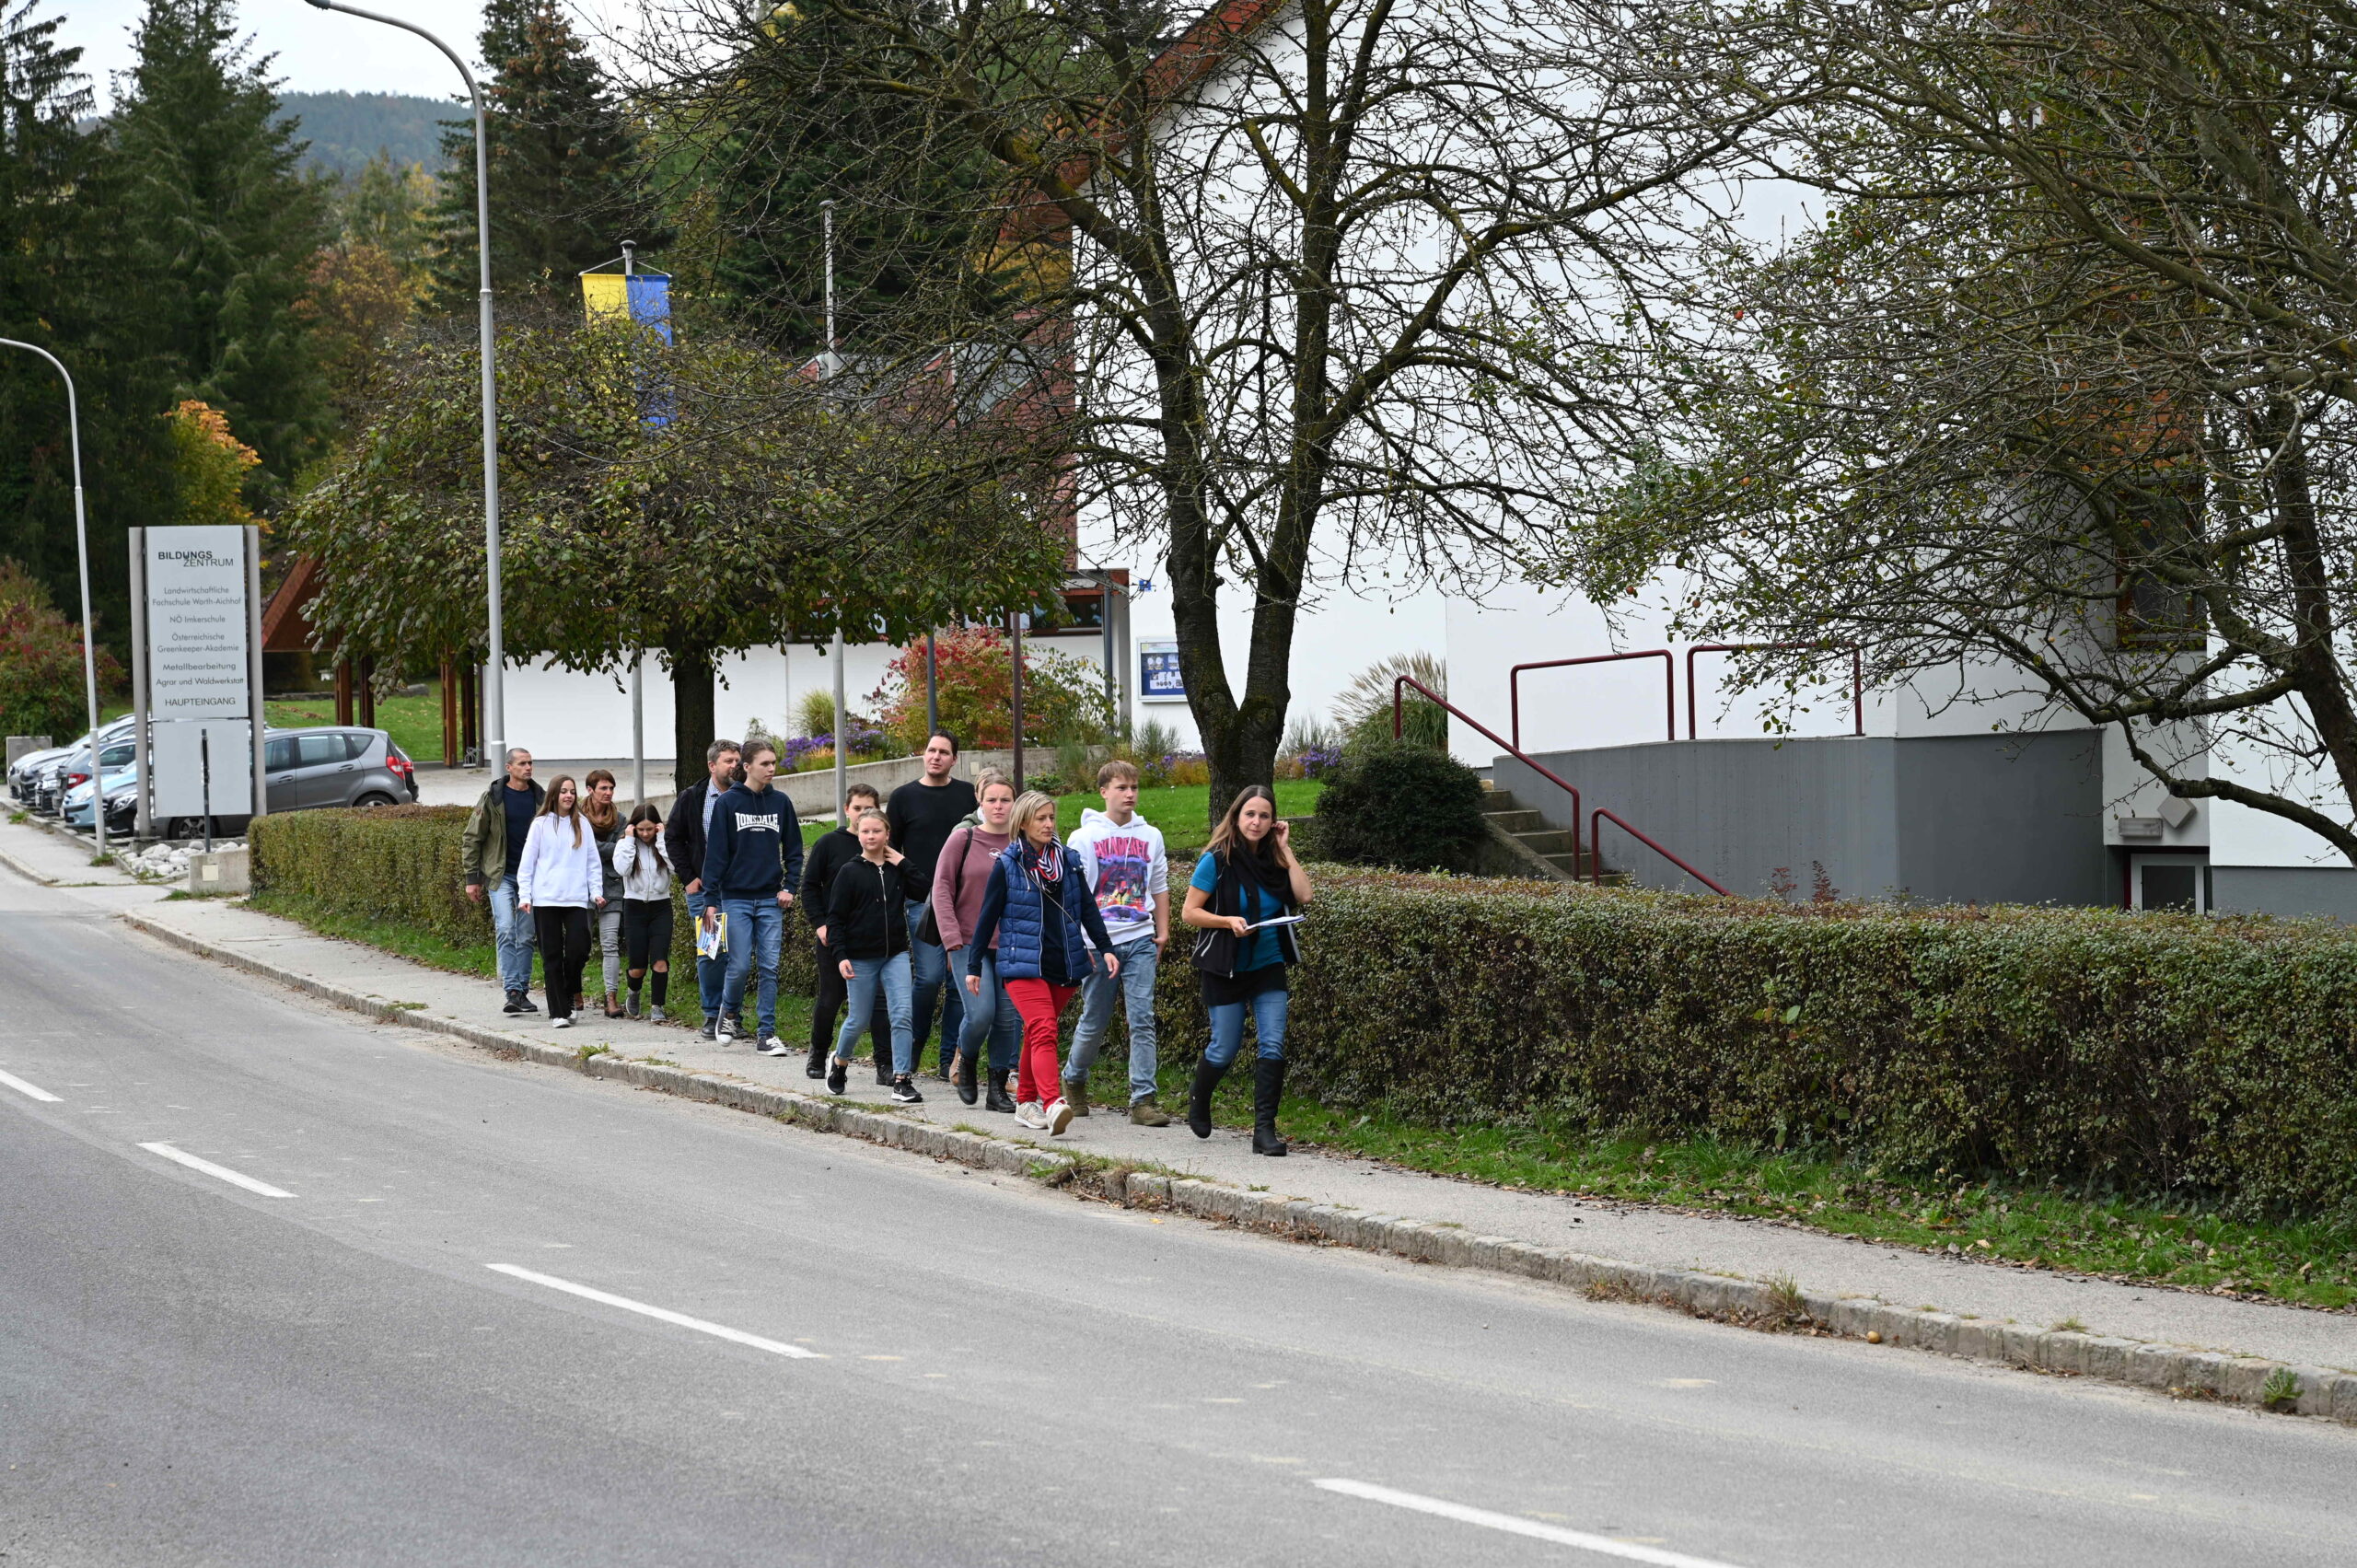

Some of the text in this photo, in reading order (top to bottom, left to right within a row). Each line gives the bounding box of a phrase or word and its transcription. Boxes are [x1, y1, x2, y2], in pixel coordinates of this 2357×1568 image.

[158, 551, 213, 560] BILDUNGS
[183, 558, 234, 567] ZENTRUM
[164, 586, 229, 595] Landwirtschaftliche
[152, 597, 241, 607] Fachschule Warth-Aichhof
[169, 614, 226, 624] NÖ Imkerschule
[171, 632, 226, 642] Österreichische
[157, 644, 239, 654] Greenkeeper-Akademie
[162, 662, 237, 671] Metallbearbeitung
[156, 676, 244, 688] Agrar und Waldwerkstatt
[165, 697, 236, 706] HAUPTEINGANG
[735, 812, 780, 832] LONSDALE
